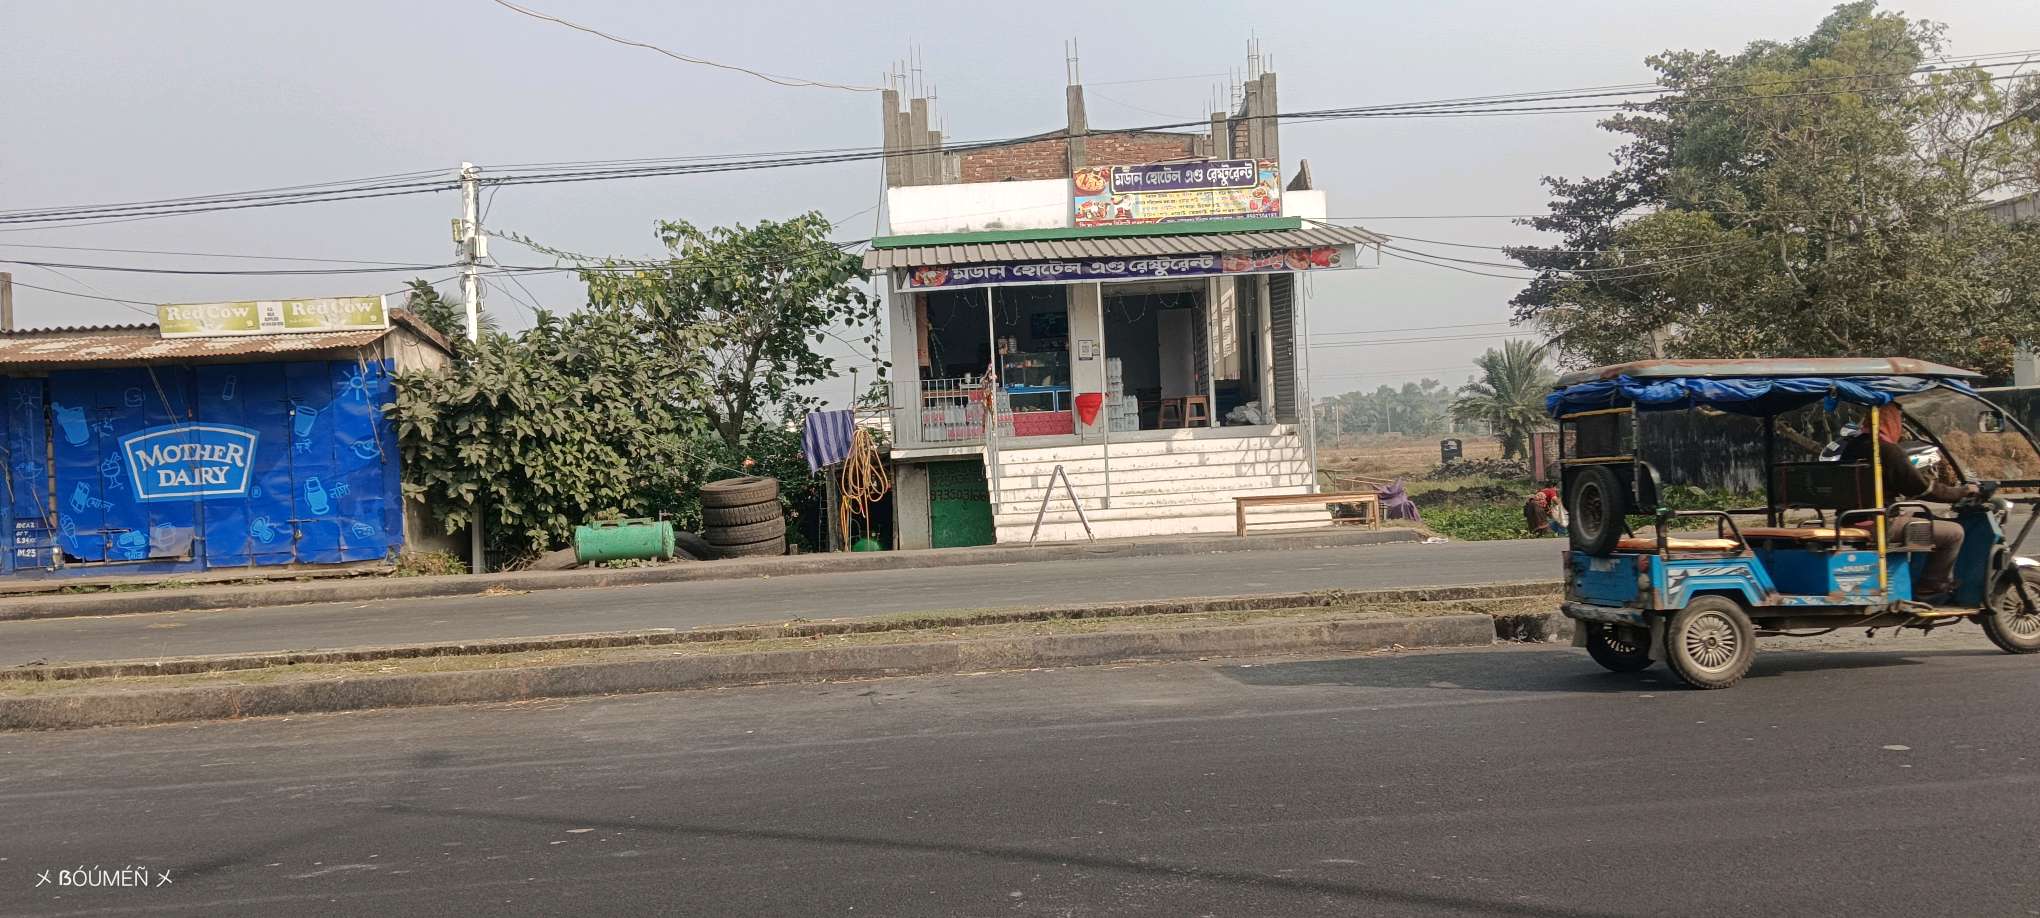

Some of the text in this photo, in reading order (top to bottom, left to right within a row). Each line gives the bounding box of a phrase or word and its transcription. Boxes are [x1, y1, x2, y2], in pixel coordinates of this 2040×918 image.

[1146, 167, 1182, 185] হোটেল
[1013, 260, 1081, 277] হোটেল
[166, 303, 249, 321] Red Cow
[291, 299, 374, 316] Red Cow
[135, 442, 244, 472] MOTHER
[157, 466, 230, 487] DAIRY
